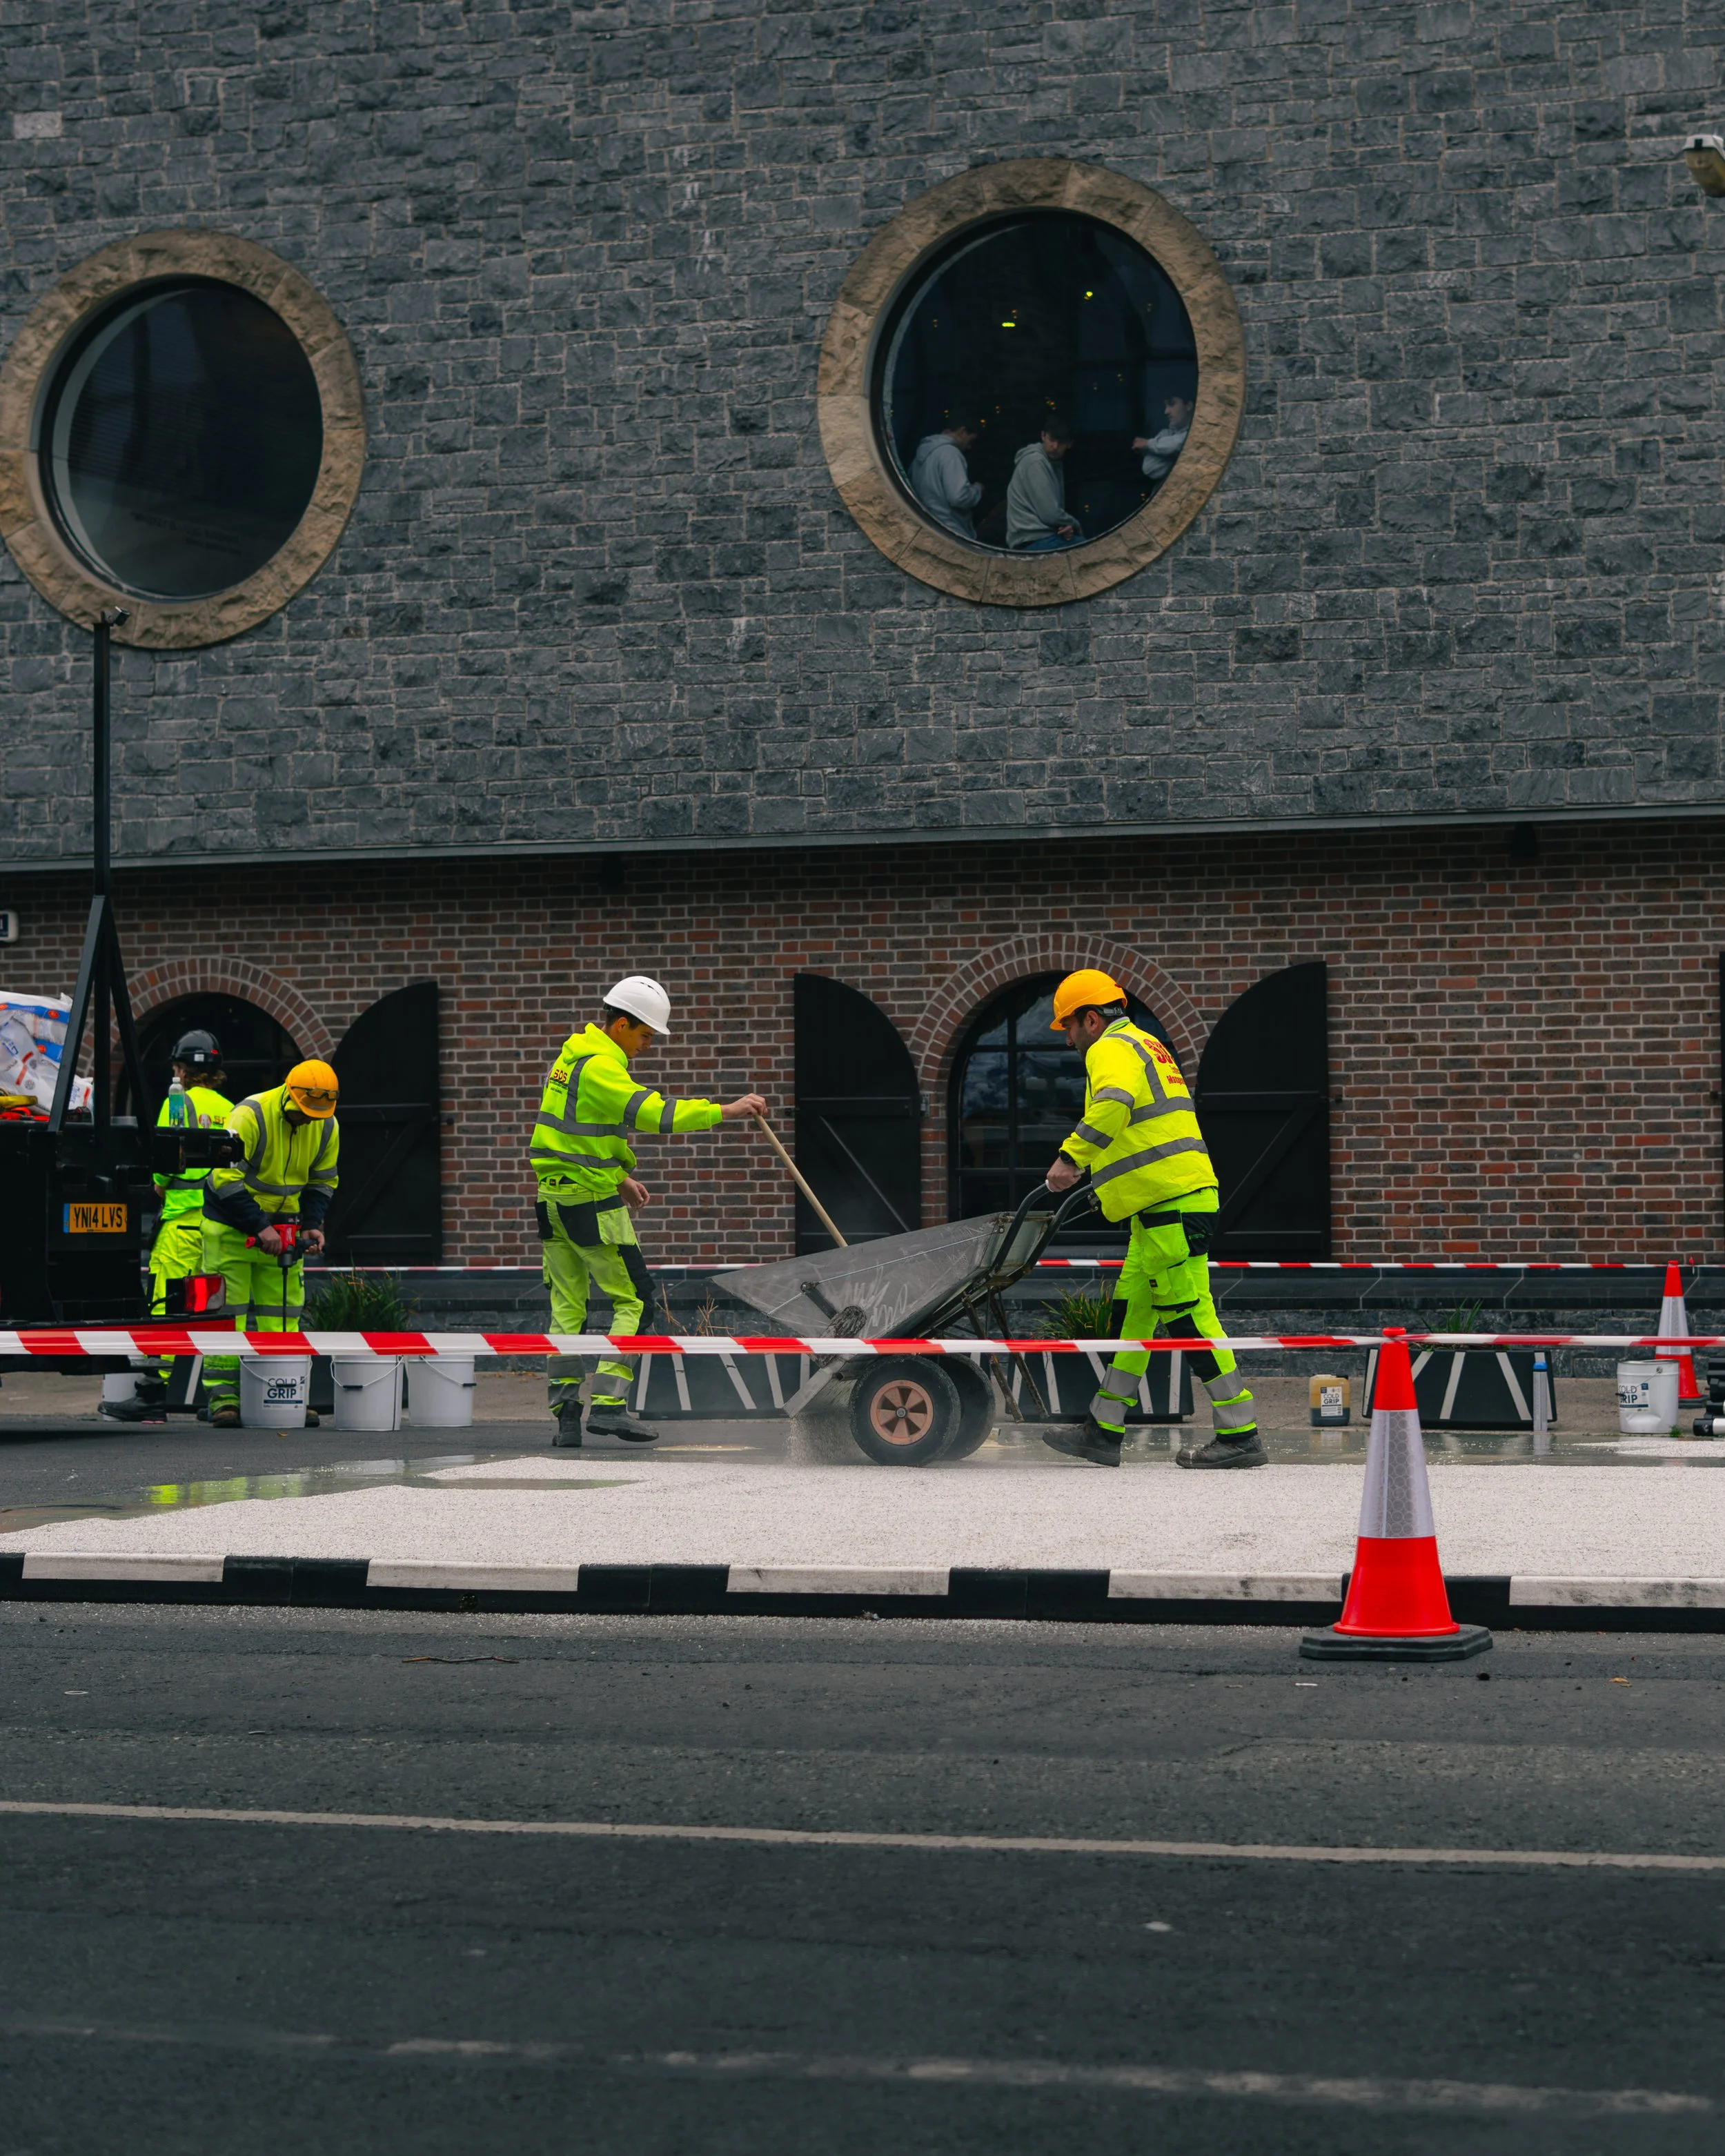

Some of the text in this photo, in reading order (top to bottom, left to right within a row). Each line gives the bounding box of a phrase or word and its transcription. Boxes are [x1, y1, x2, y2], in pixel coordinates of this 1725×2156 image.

[553, 1069, 568, 1082] SOS
[74, 1207, 123, 1228] YN14 LVS
[268, 1378, 297, 1387] COLD
[267, 1388, 297, 1398] GRIP
